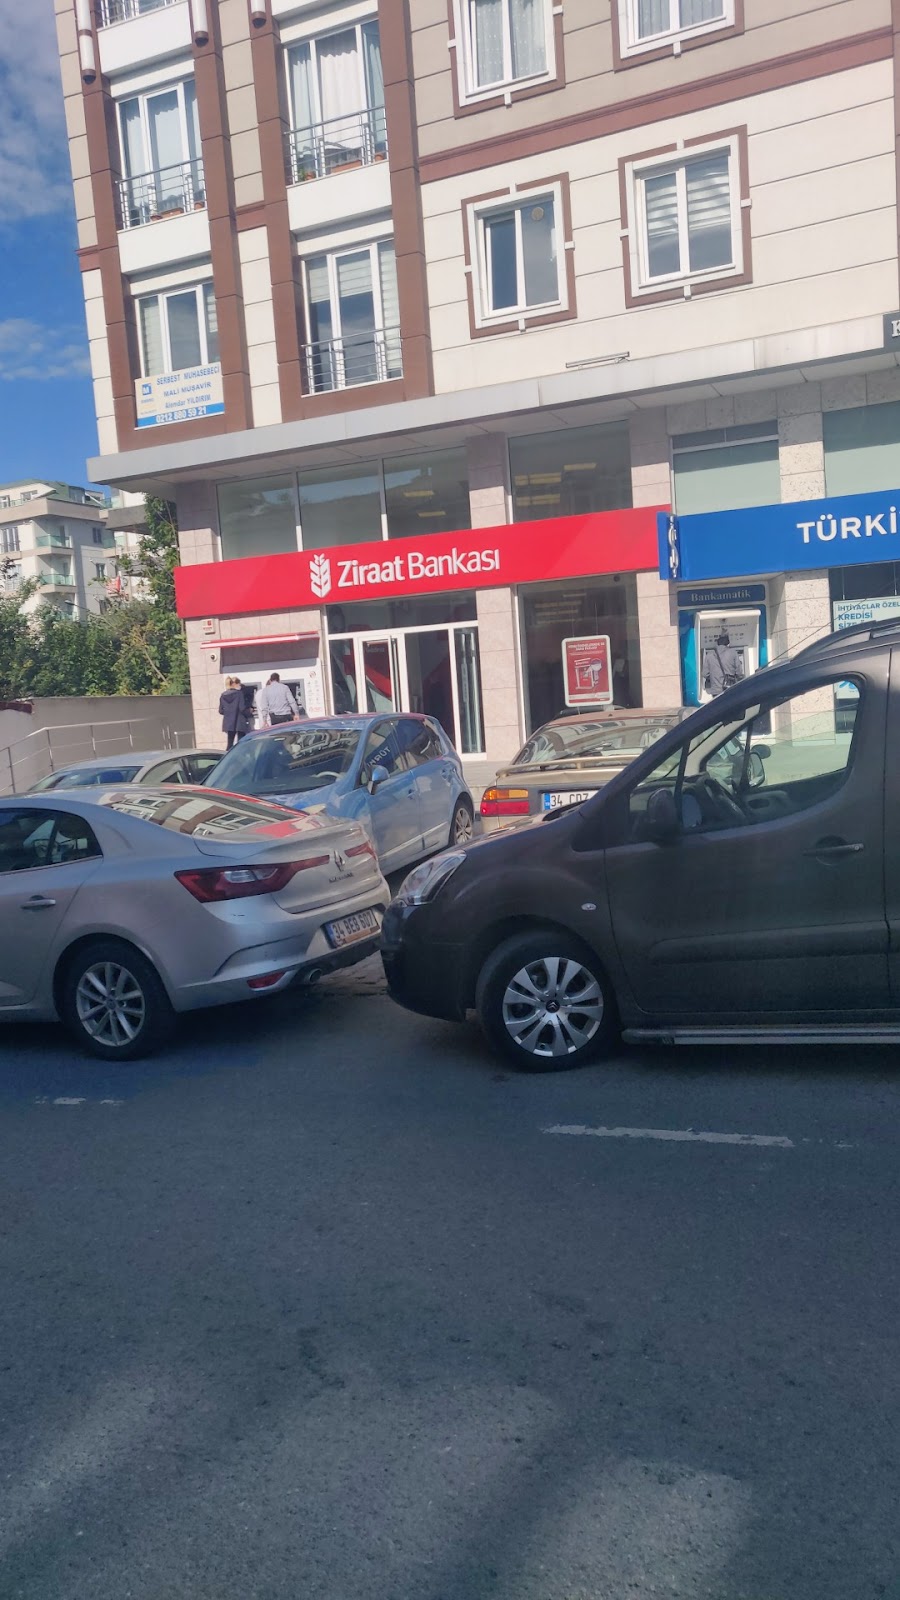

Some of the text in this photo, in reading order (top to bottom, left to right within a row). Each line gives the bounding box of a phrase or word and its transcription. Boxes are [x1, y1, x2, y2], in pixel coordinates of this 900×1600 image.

[157, 374, 180, 385] SERBEST
[155, 412, 173, 423] 0212
[187, 407, 197, 418] 59
[197, 405, 207, 416] 21
[796, 506, 900, 544] TÜRKİ
[337, 547, 501, 588] Ziraat Bankası
[690, 589, 751, 602] Bankamatik
[837, 602, 881, 612] İHTİYAÇLAR
[838, 609, 873, 621] KREDİSİ
[551, 795, 563, 807] 34
[332, 922, 346, 939] 34
